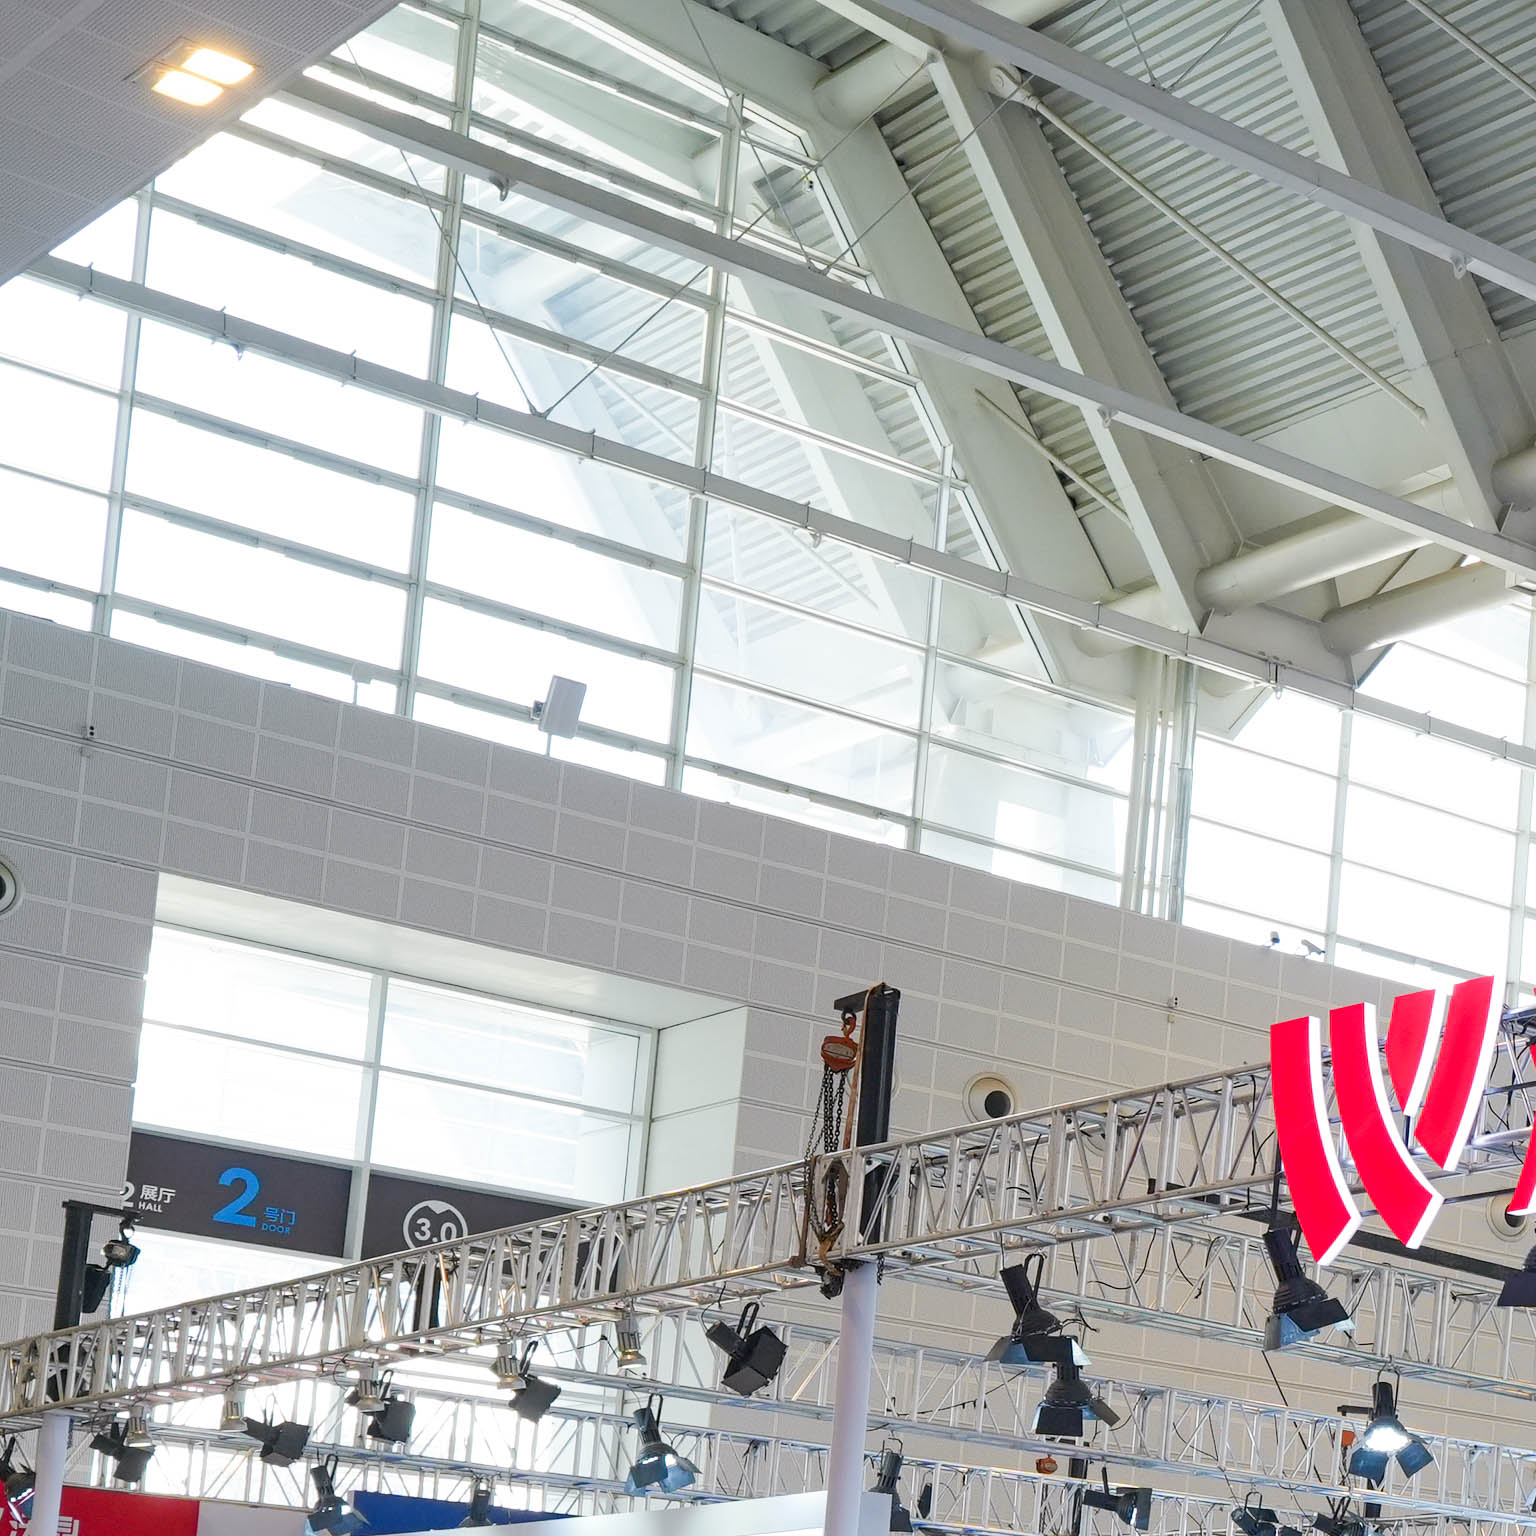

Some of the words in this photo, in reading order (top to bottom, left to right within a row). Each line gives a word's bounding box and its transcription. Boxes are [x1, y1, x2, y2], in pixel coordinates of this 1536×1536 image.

[139, 1184, 176, 1204] 展厅
[212, 1167, 261, 1228] 2
[138, 1202, 163, 1214] HALL
[263, 1207, 297, 1226] 号门
[261, 1223, 291, 1236] DOOR
[414, 1217, 457, 1243] 3.0
